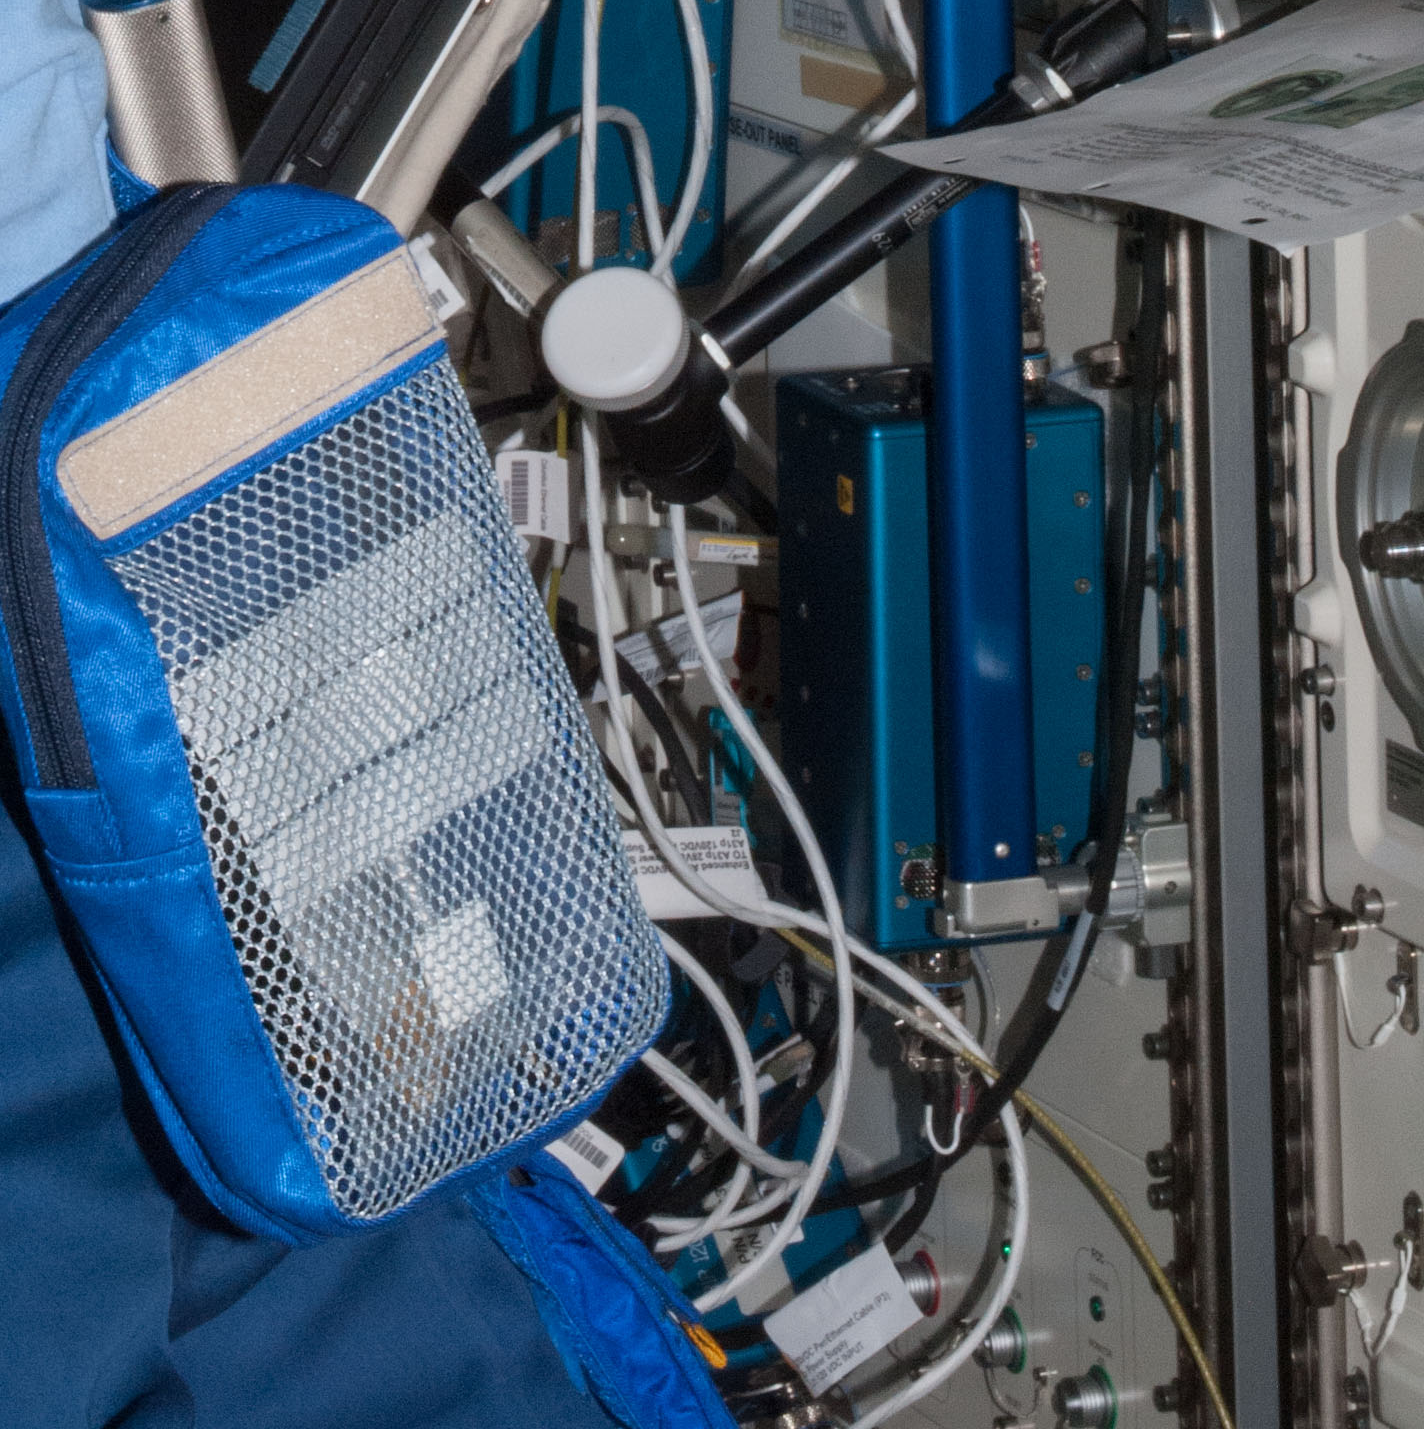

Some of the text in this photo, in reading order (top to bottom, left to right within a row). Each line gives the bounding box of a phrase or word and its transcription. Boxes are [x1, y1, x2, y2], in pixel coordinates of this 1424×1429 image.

[728, 117, 800, 155] SE-OUT PANEL
[719, 837, 745, 847] A31p
[704, 850, 730, 859] A31p
[732, 848, 747, 858] TO
[700, 860, 750, 872] Enhanced
[852, 1300, 876, 1323] Cable
[824, 1337, 851, 1362] Supply
[825, 1356, 845, 1375] VDC
[840, 1339, 867, 1364] INPUT
